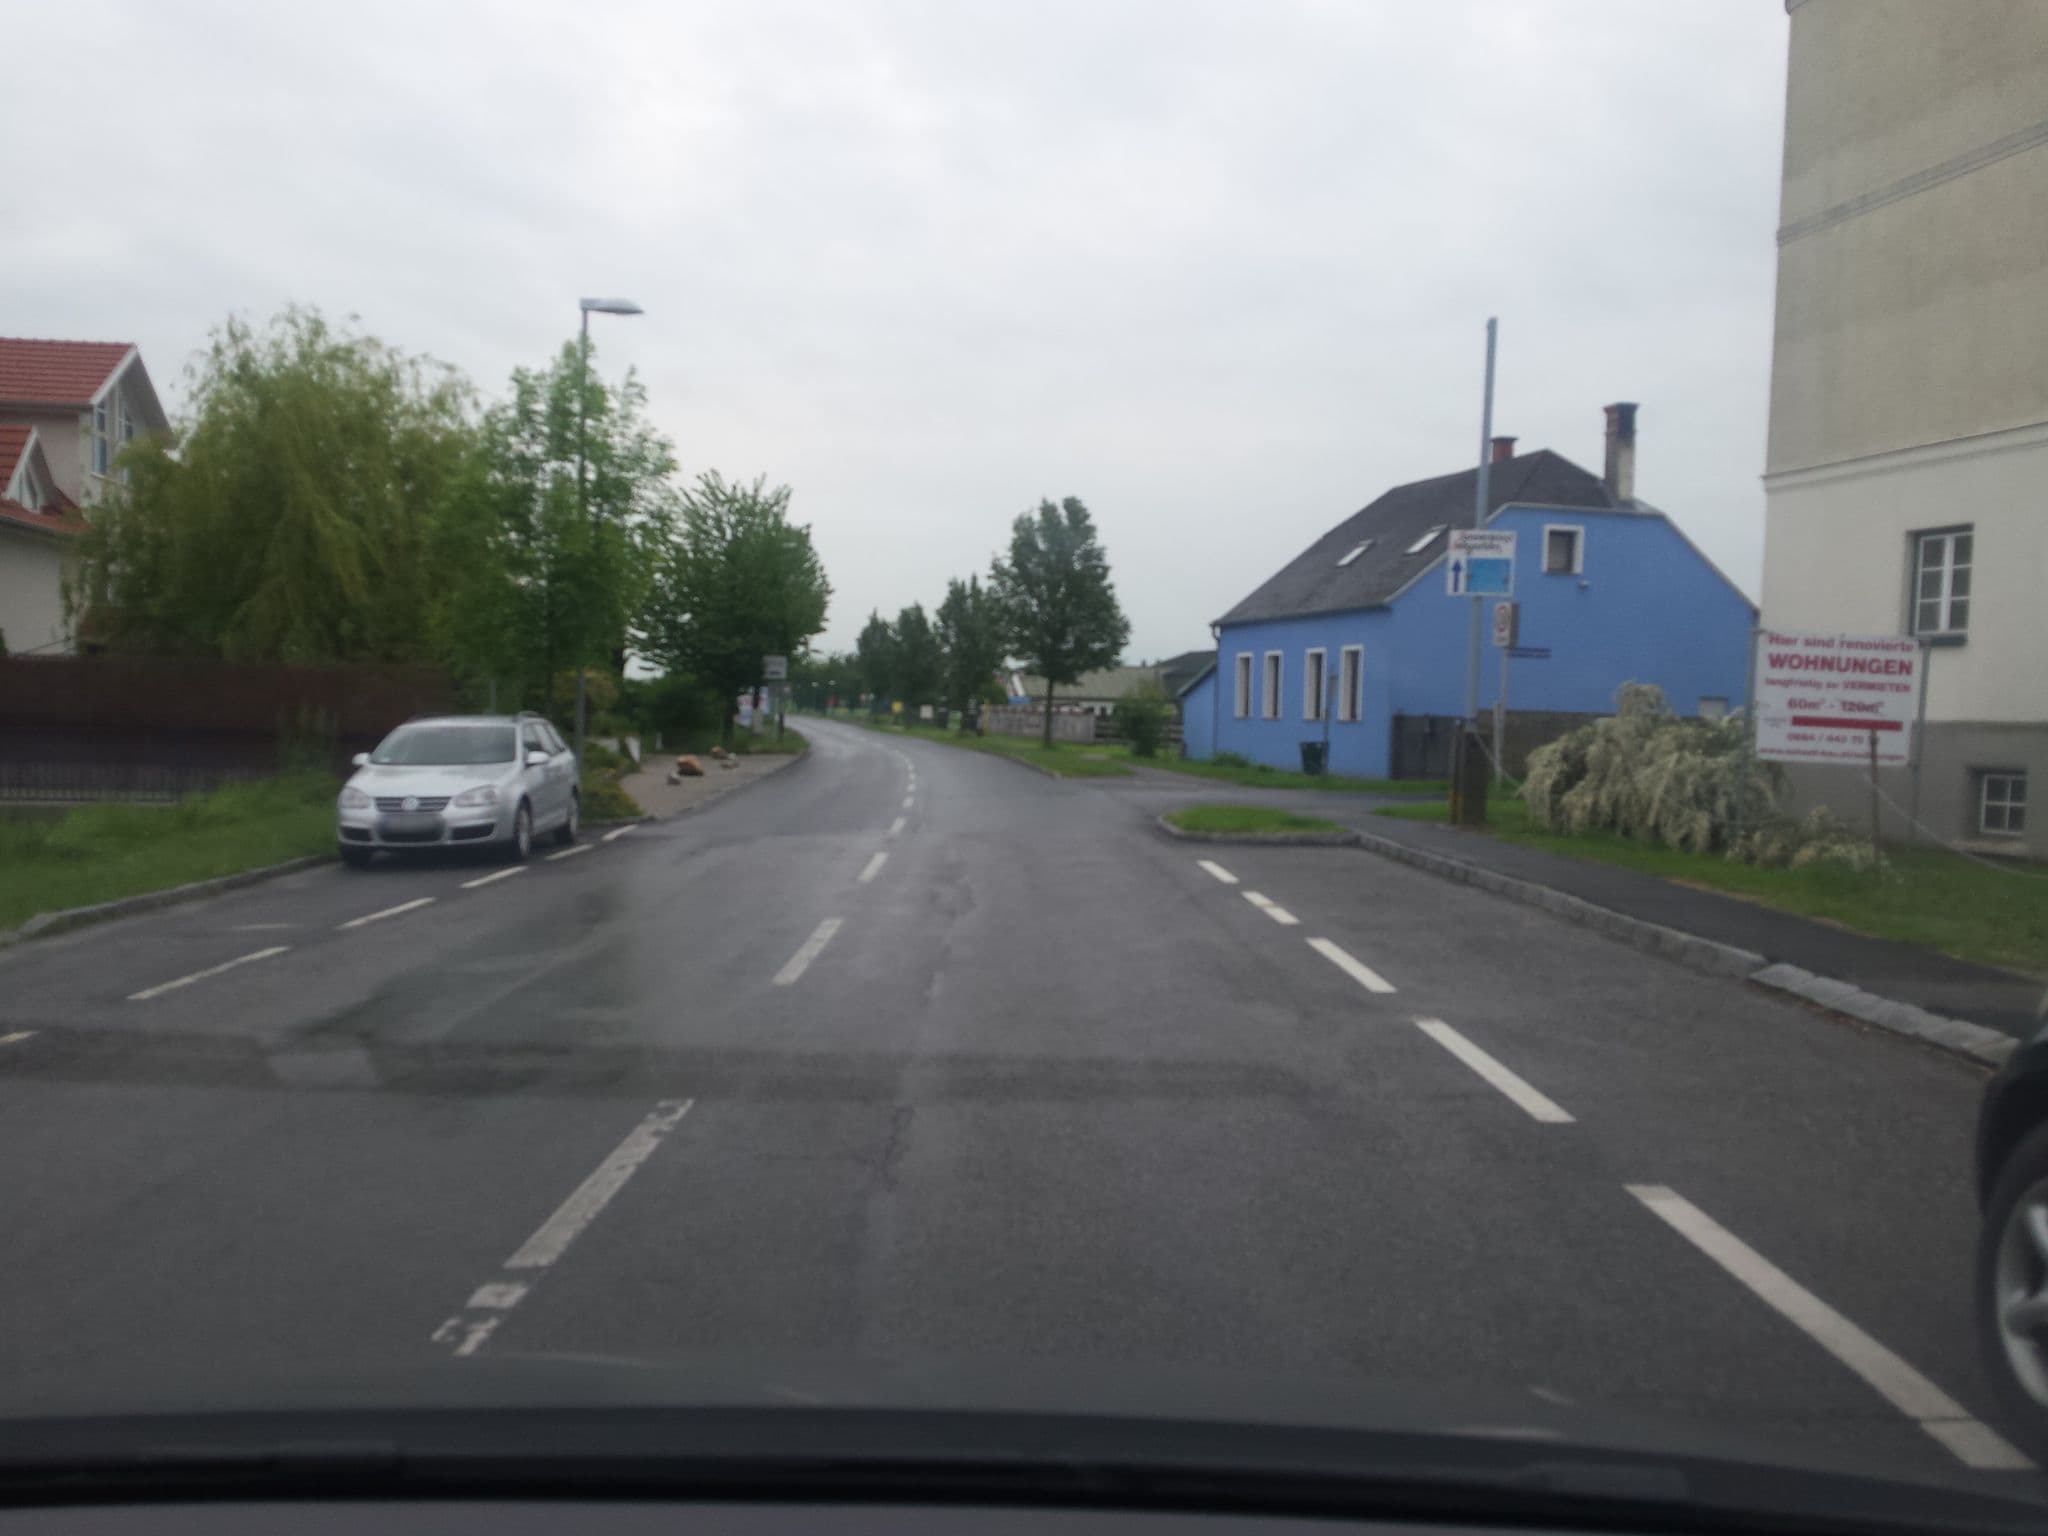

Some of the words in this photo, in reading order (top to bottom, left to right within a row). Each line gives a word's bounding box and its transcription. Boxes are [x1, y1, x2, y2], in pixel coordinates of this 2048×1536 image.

[1767, 633, 1799, 646] Hier
[1803, 635, 1835, 648] sind
[1839, 639, 1914, 652] renovierte
[1768, 653, 1914, 676] WOHNUNGEN
[1842, 680, 1911, 693] VERMIETEN
